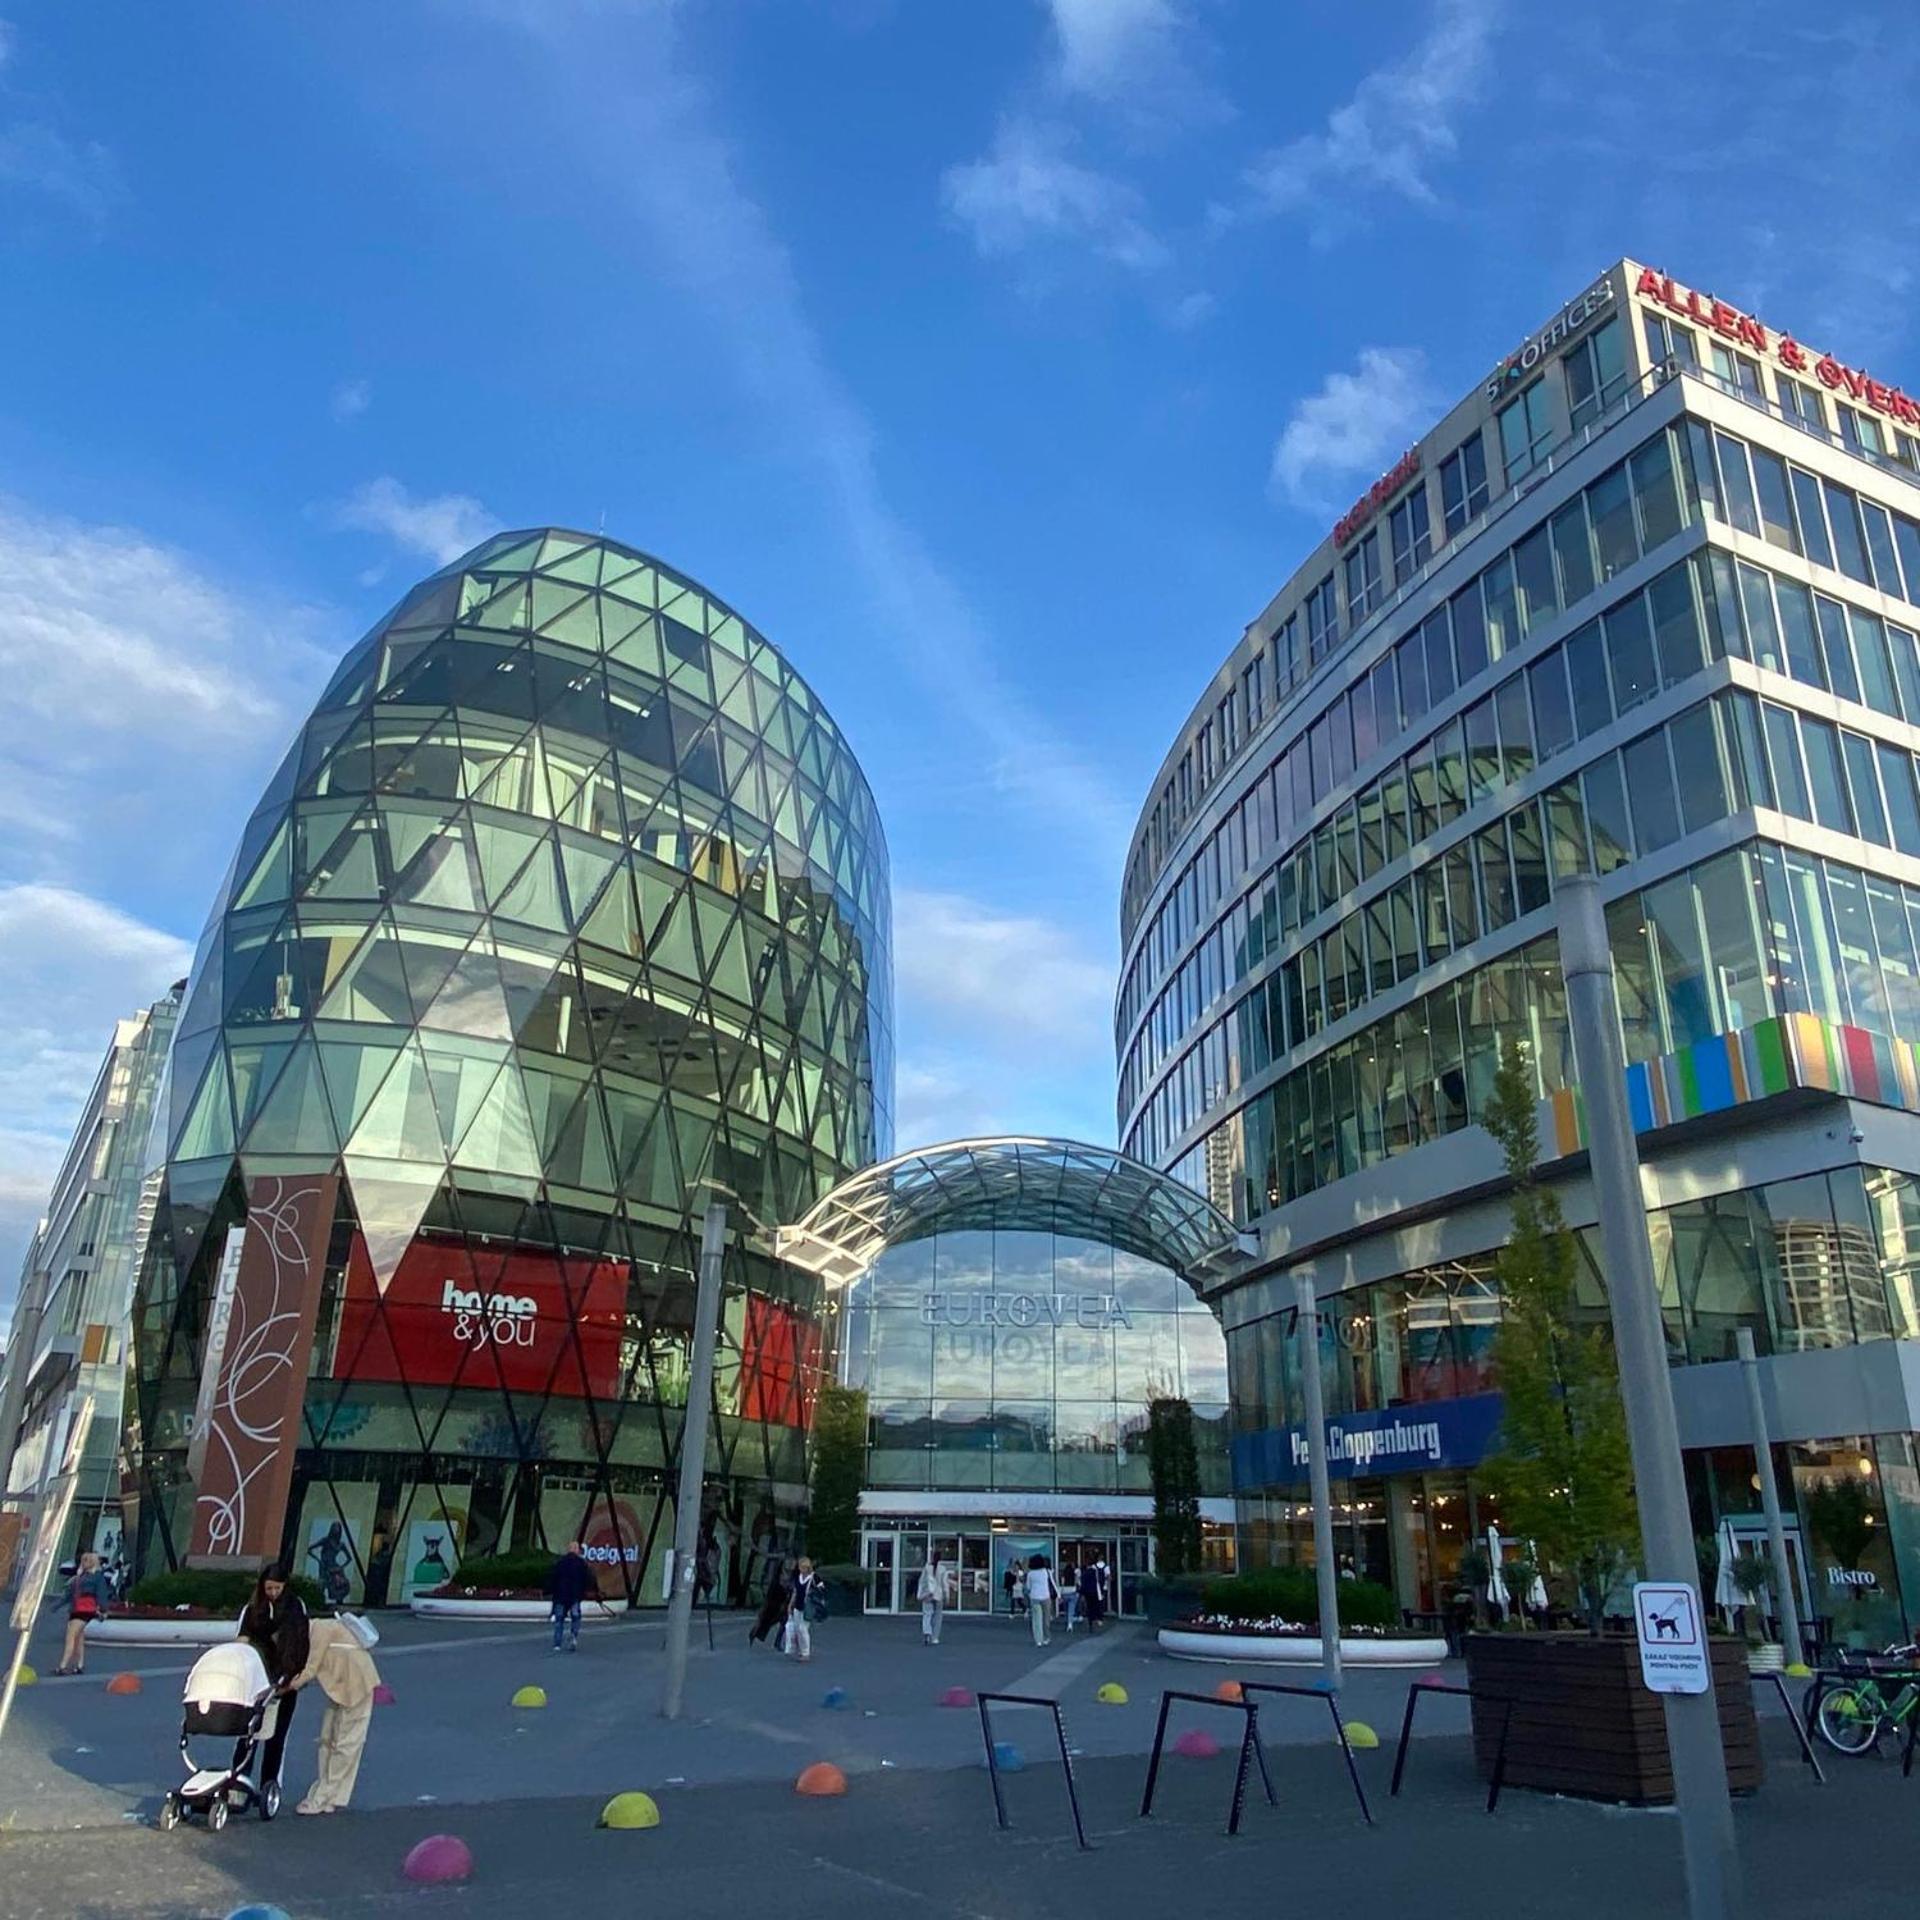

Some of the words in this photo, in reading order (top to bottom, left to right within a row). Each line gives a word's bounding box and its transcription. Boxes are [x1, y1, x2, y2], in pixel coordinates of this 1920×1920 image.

[1635, 267, 1768, 353] ALLEN
[1778, 339, 1807, 372] &
[441, 1280, 538, 1320] home
[920, 1292, 1133, 1329] EUROVEA
[1827, 1566, 1876, 1585] Bistro
